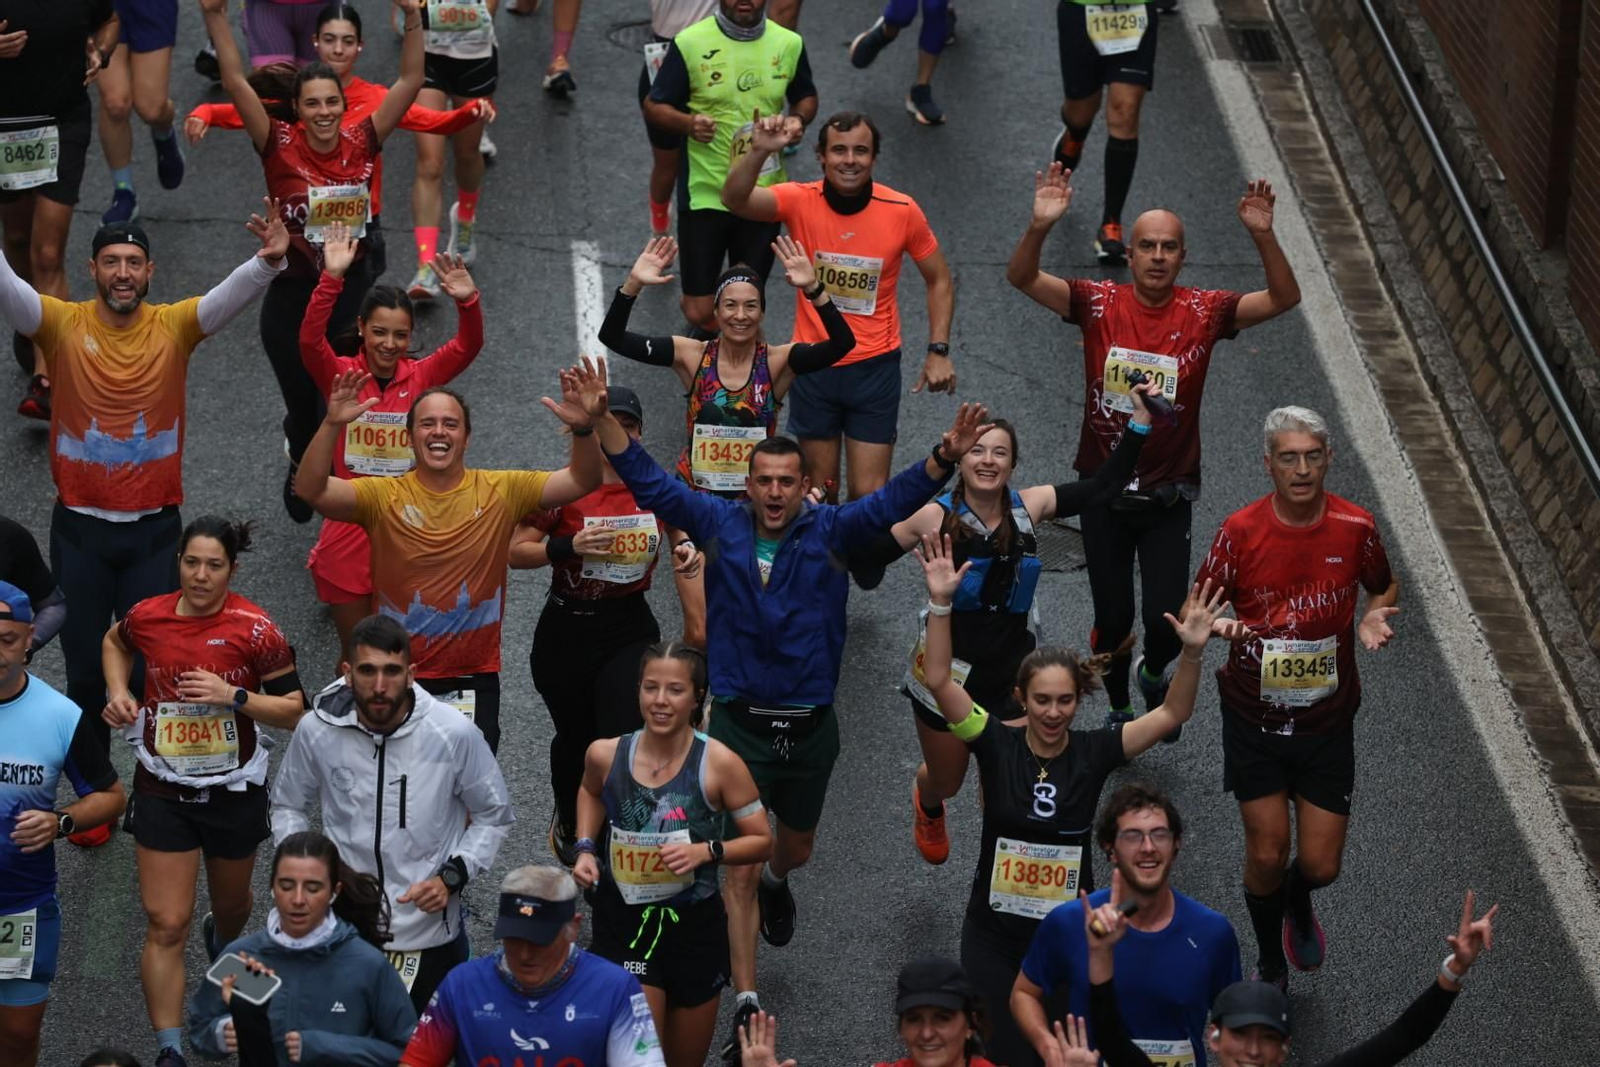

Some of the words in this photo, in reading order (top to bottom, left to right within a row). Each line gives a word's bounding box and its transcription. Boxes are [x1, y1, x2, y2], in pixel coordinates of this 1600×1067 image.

[1093, 14, 1137, 32] 11429
[4, 143, 45, 163] 8462
[315, 200, 364, 219] 13086
[818, 266, 868, 290] 10858
[353, 425, 410, 448] 10610
[699, 441, 756, 462] 13432
[1269, 656, 1328, 678] 13345
[164, 719, 222, 744] 13641
[1002, 858, 1066, 887] 13830
